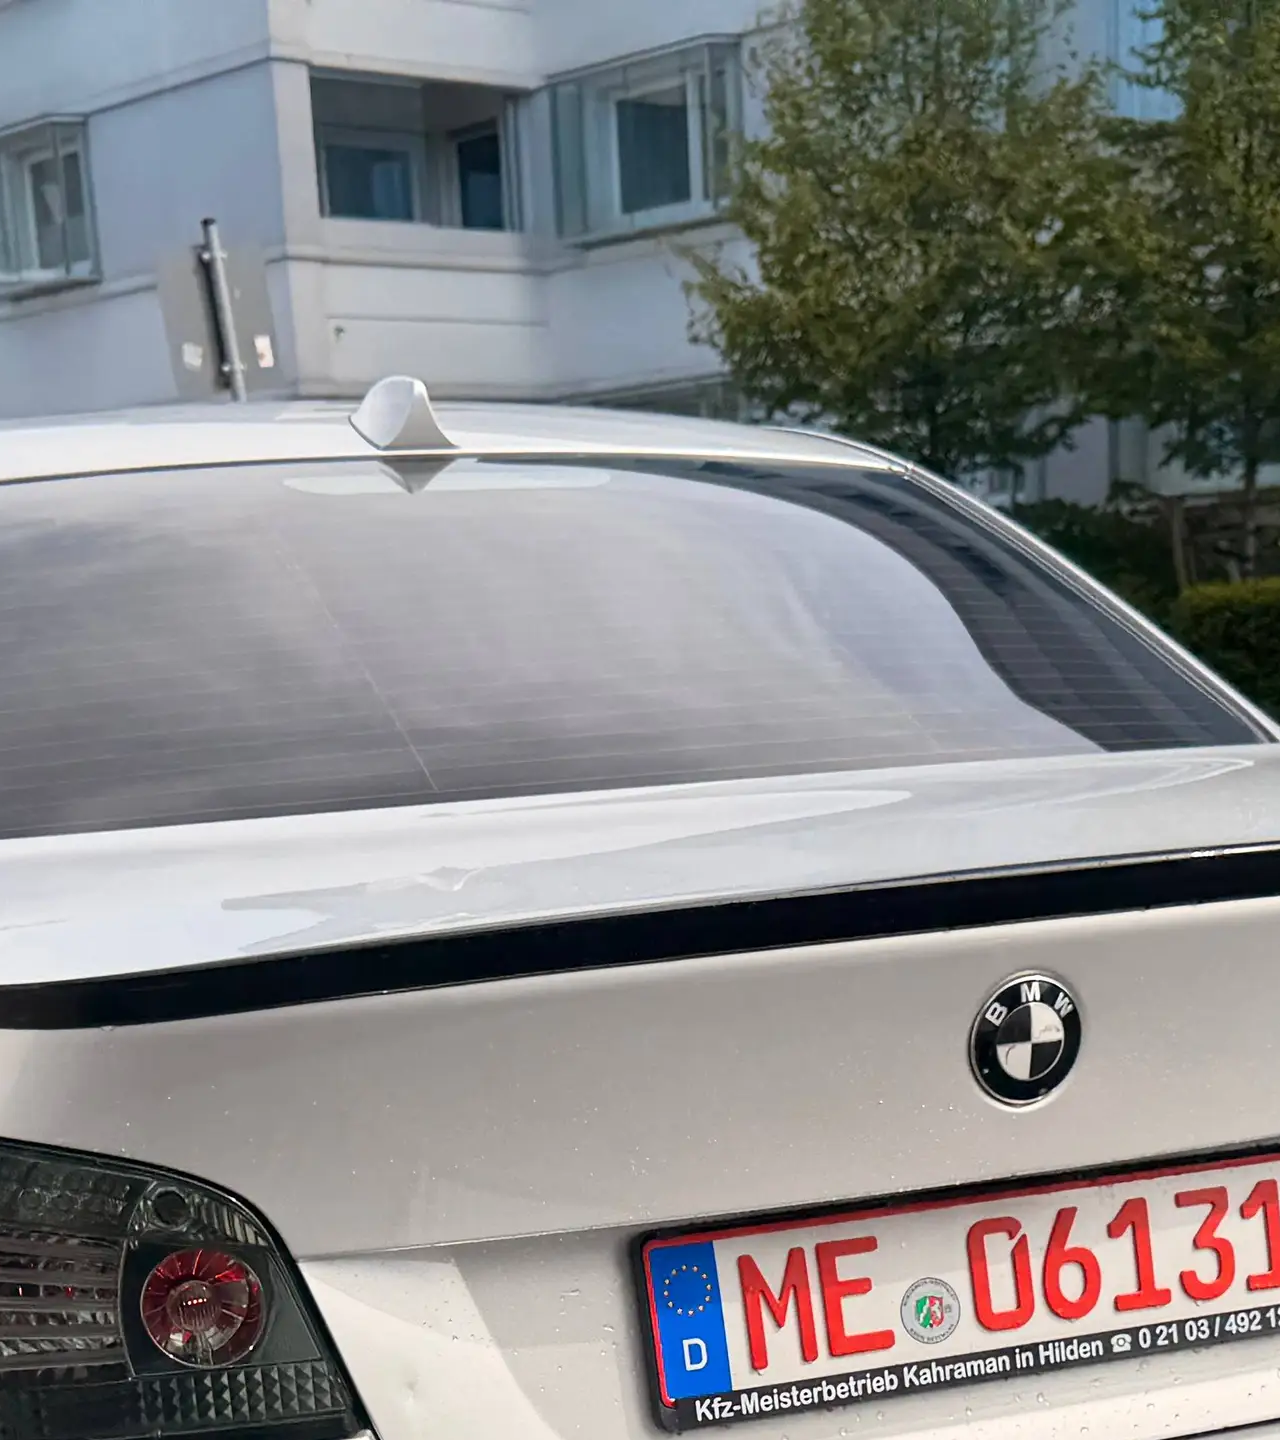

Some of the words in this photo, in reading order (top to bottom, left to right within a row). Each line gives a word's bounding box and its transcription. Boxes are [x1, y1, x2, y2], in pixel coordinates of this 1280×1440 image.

[984, 981, 1075, 1027] BMW
[737, 1235, 896, 1370] ME
[682, 1337, 708, 1372] D
[694, 1370, 898, 1422] Kfz-Meisterbetrieb
[903, 1353, 1010, 1388] Kahraman
[1015, 1348, 1034, 1369] in
[1038, 1338, 1104, 1366] Hilden
[1138, 1330, 1151, 1349] 0
[1156, 1324, 1179, 1346] 21
[1184, 1319, 1210, 1341] 03
[1224, 1309, 1262, 1334] 492
